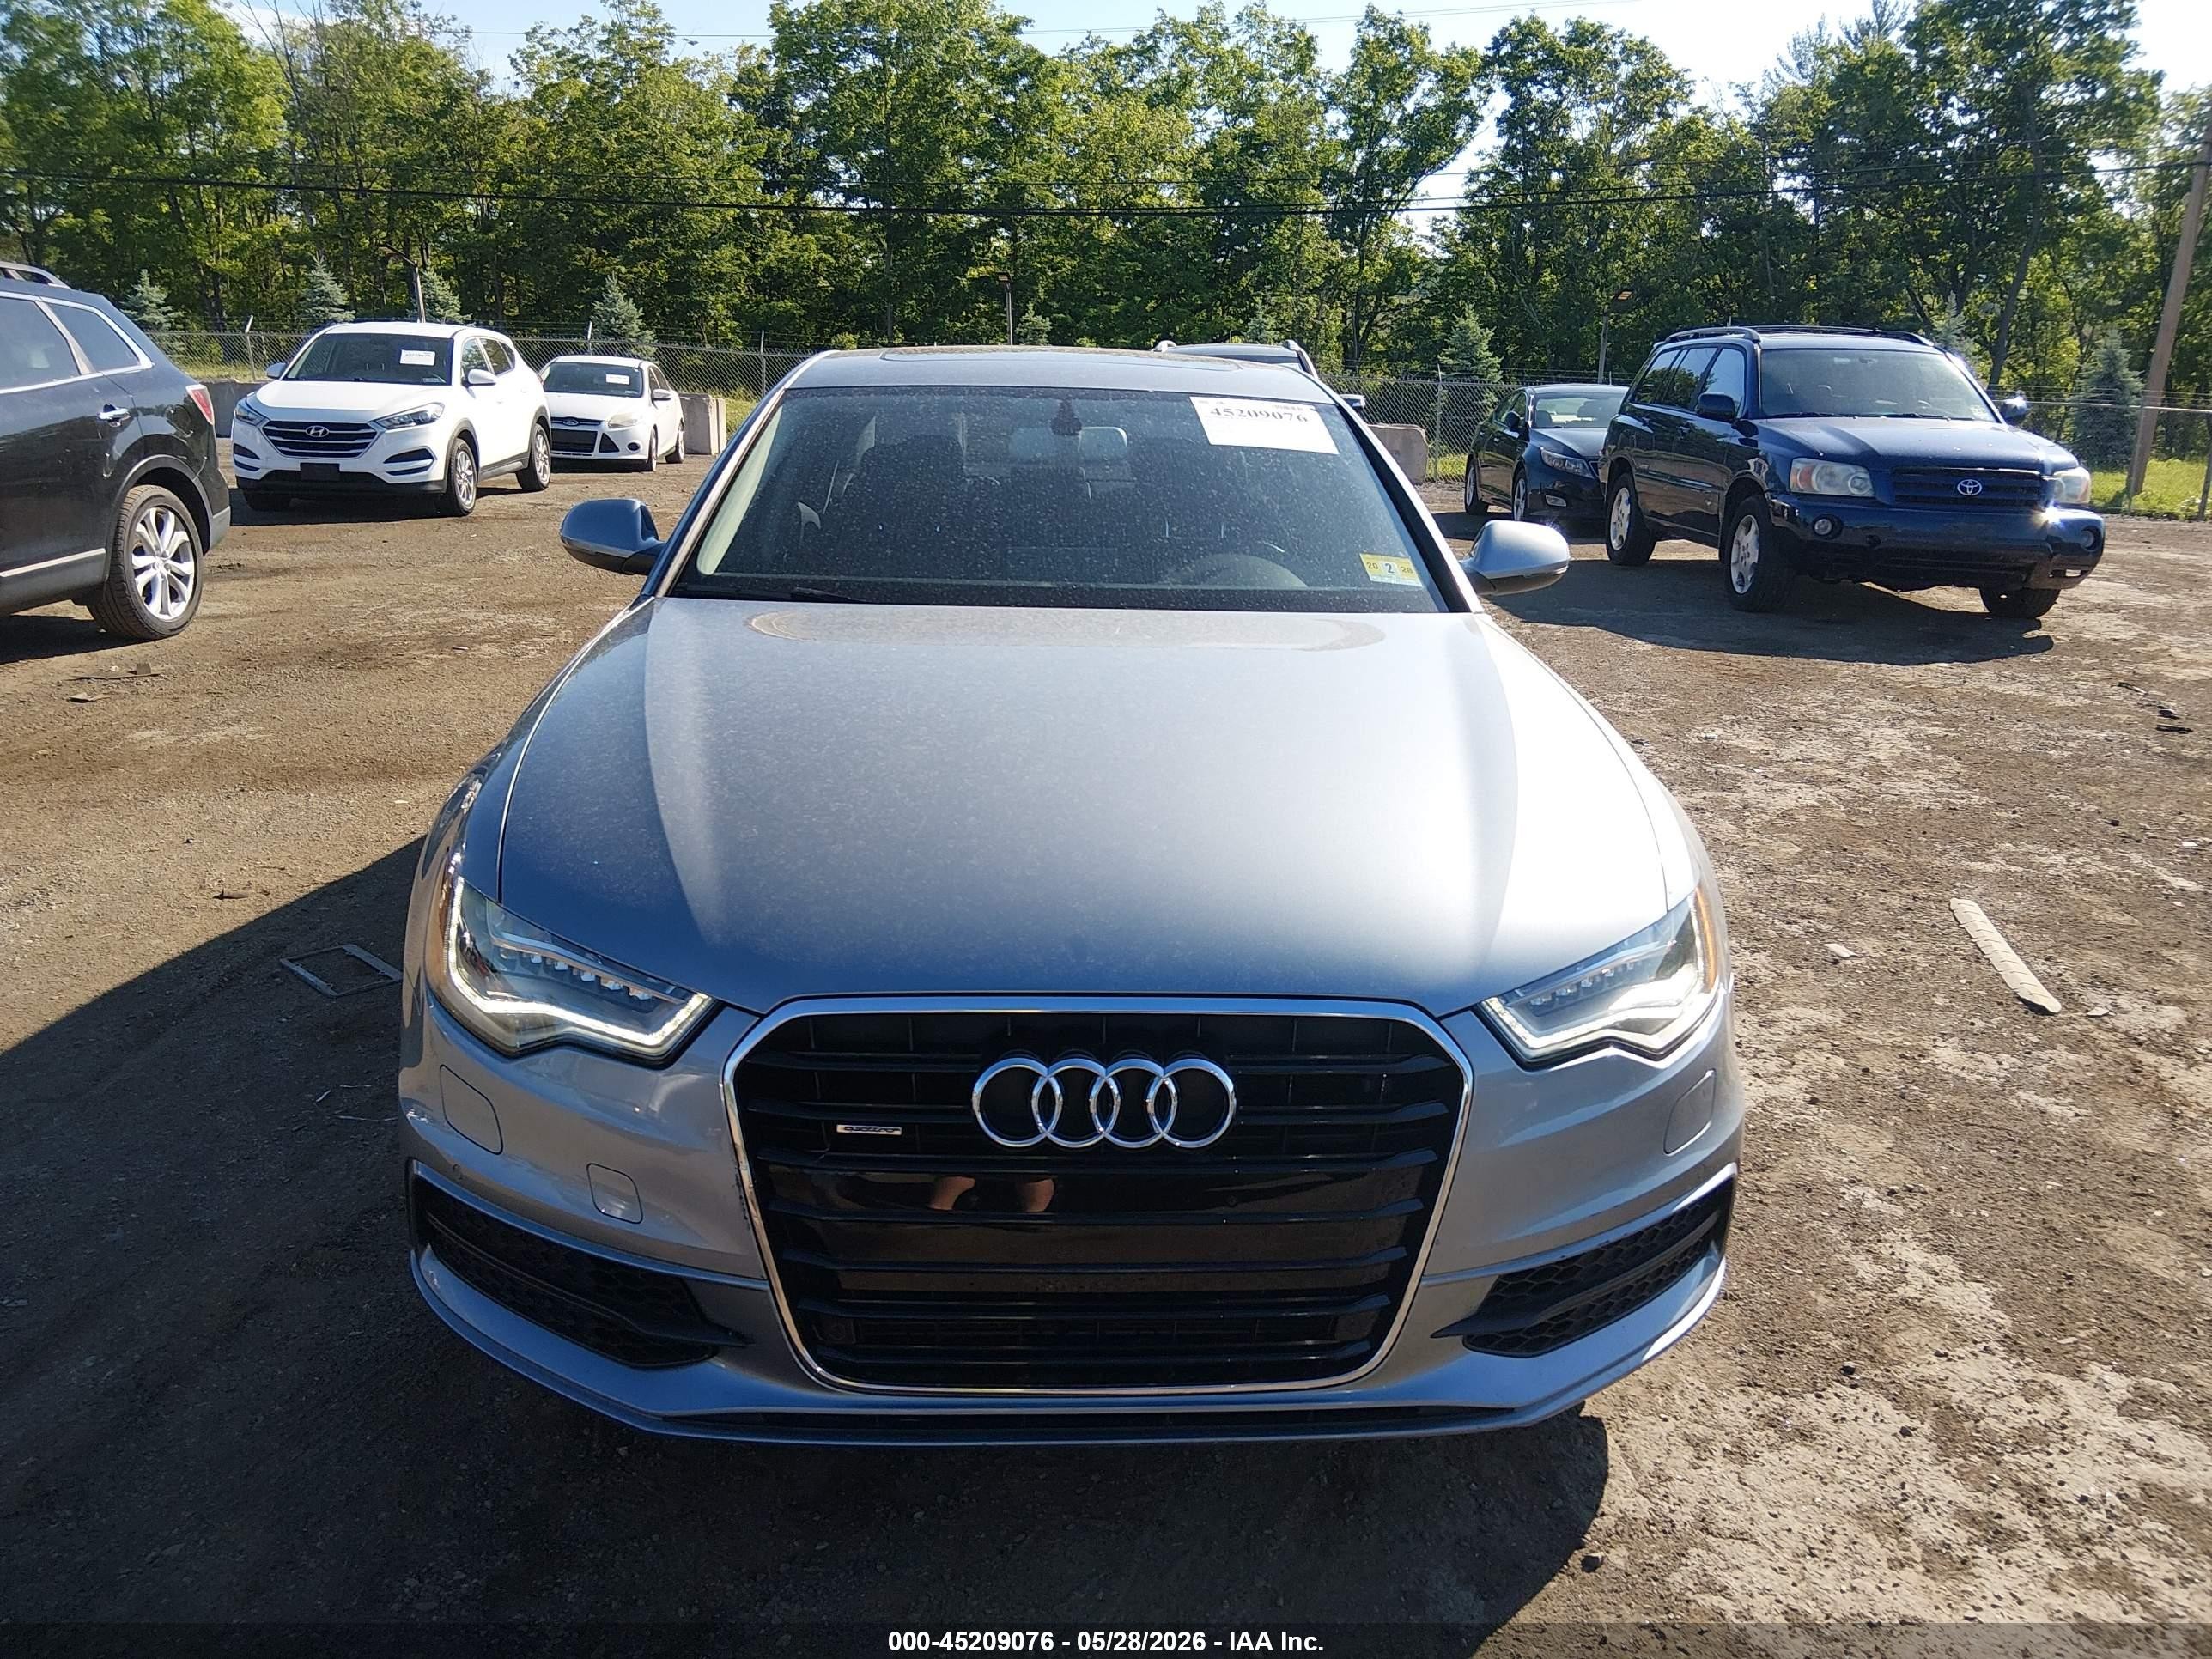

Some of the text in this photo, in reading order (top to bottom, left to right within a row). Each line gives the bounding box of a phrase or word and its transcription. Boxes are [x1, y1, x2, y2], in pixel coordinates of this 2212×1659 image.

[1210, 408, 1308, 422] 45209076
[1366, 562, 1379, 570] 20
[1384, 562, 1395, 574] 2
